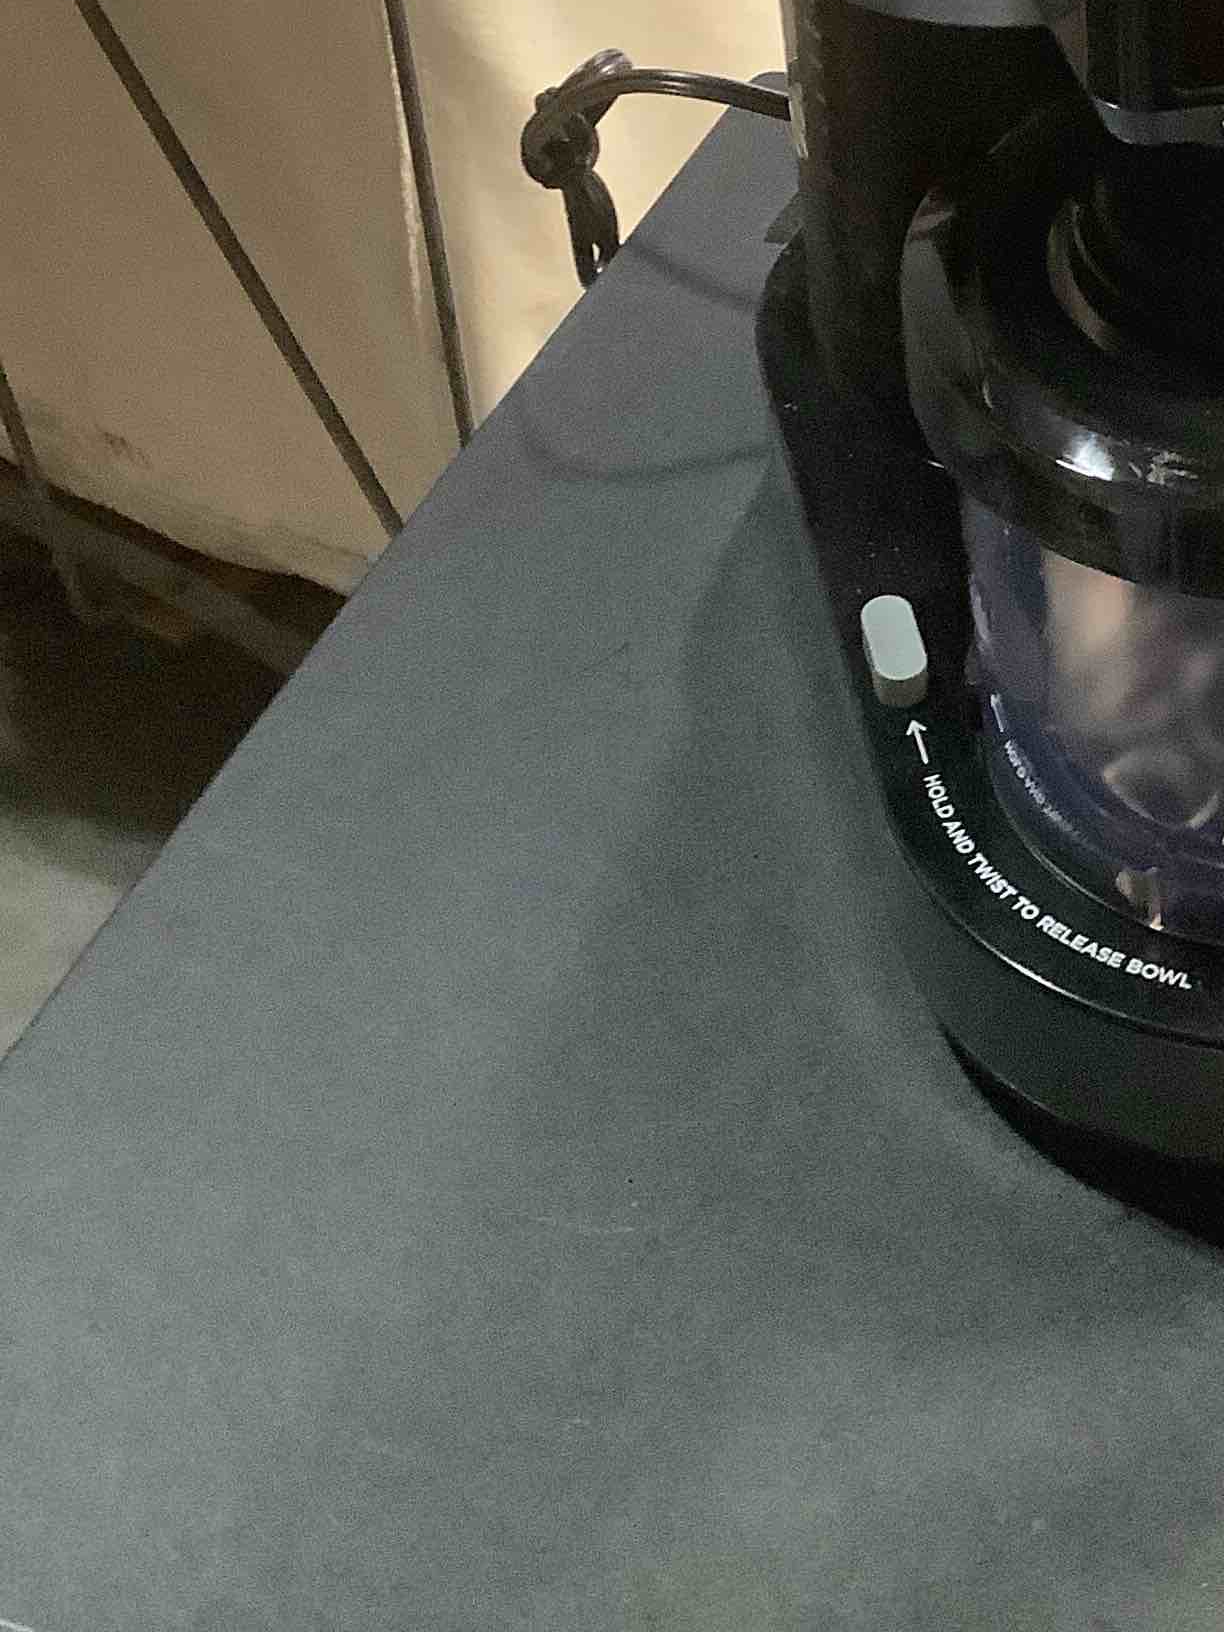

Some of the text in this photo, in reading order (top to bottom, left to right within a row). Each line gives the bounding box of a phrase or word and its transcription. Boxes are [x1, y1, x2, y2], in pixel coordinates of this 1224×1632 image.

[923, 774, 1193, 990] HOLD AND TWIST TO RELEASE BOWL
